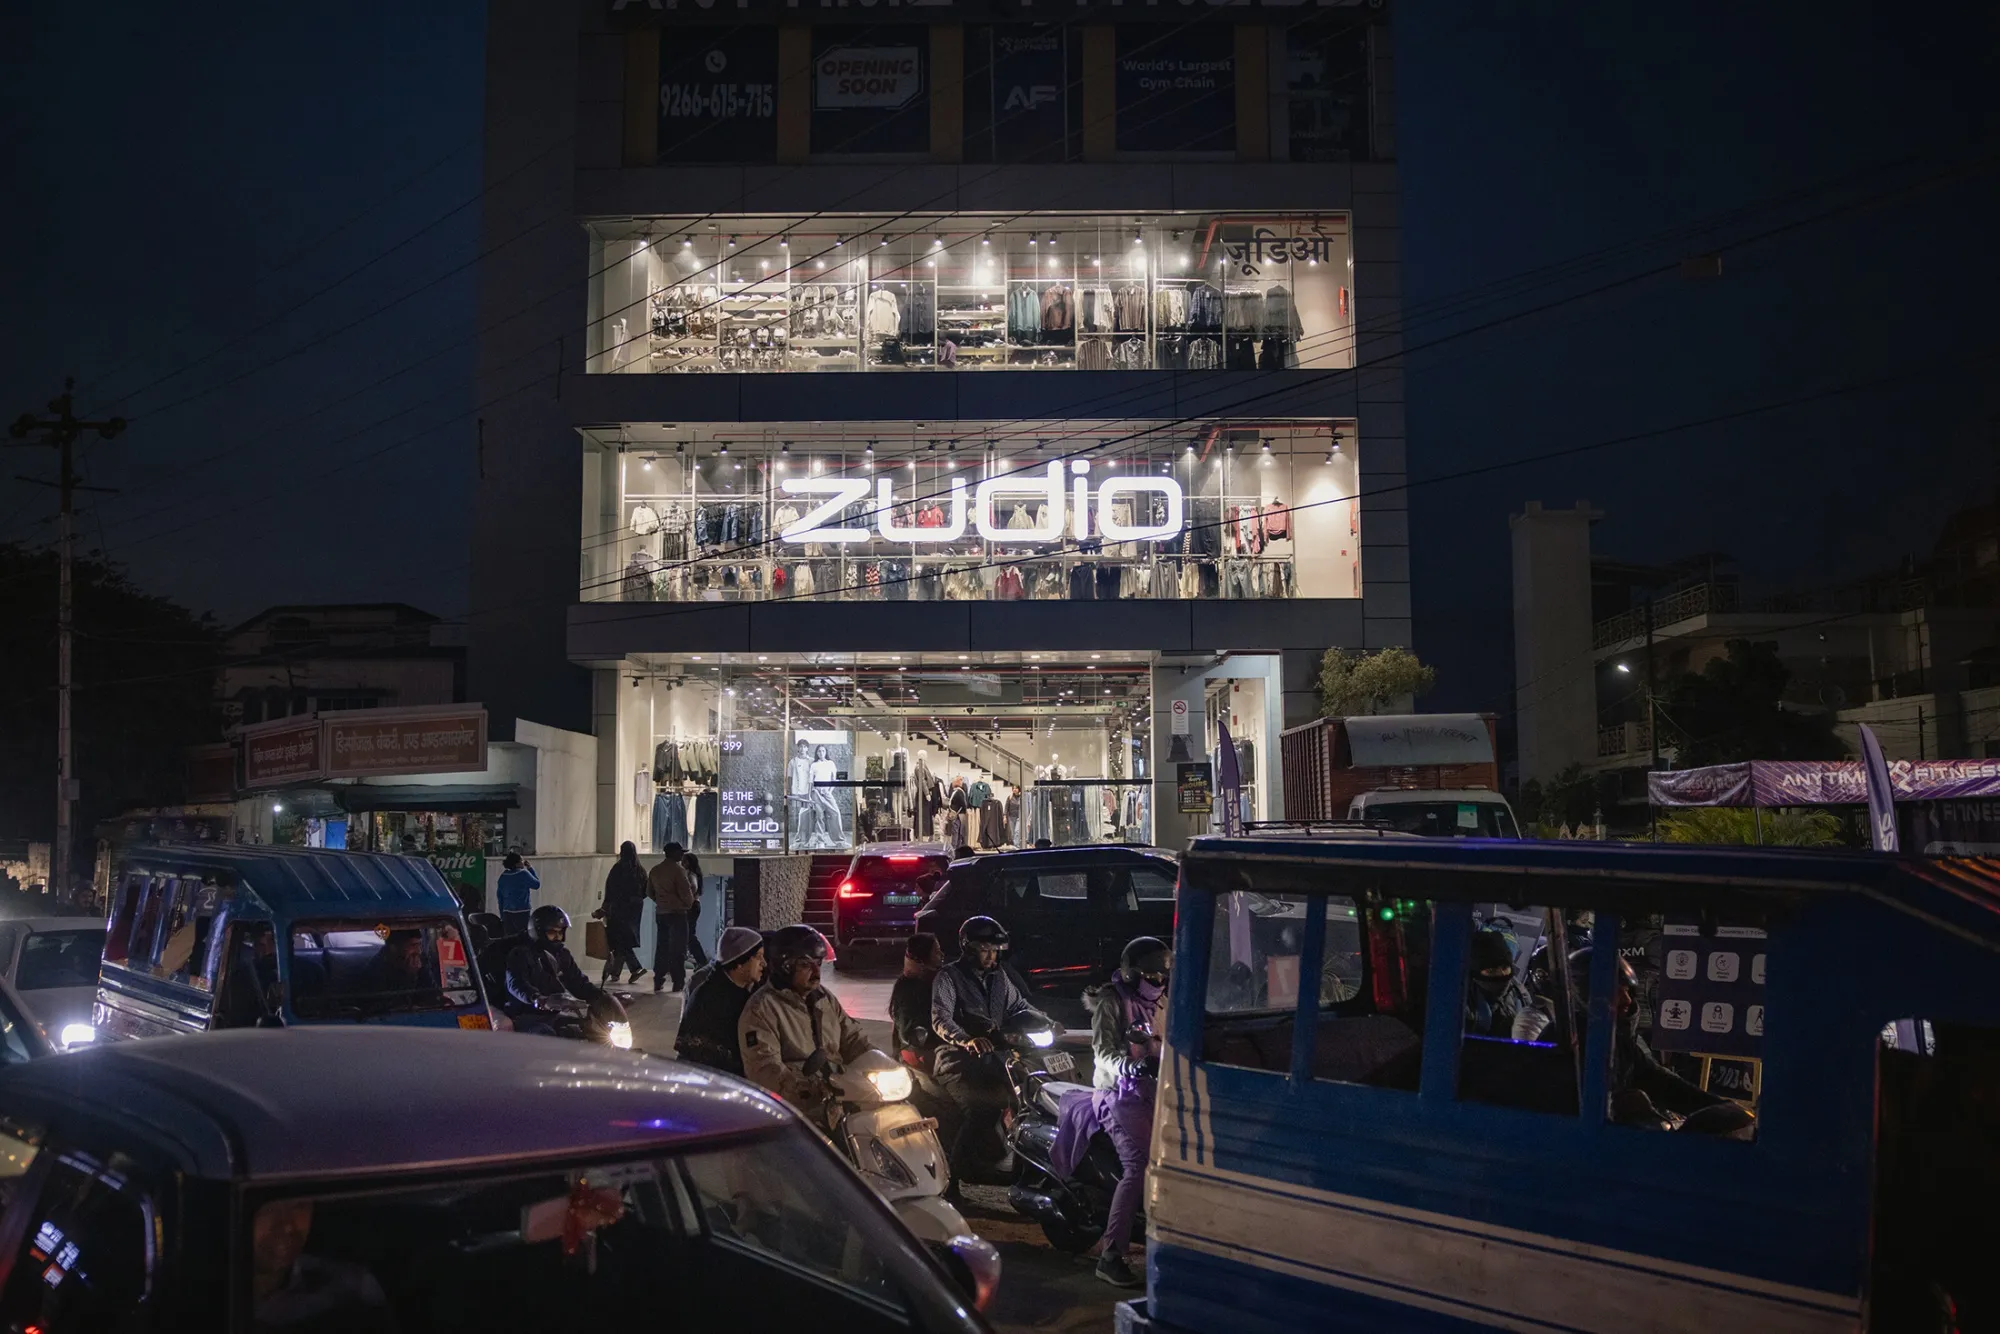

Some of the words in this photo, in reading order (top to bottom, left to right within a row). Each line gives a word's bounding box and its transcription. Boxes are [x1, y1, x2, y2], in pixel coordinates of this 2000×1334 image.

[821, 59, 913, 75] OPENING
[1122, 60, 1175, 71] World's
[1179, 60, 1231, 74] Largest
[838, 78, 897, 95] SOON
[1139, 77, 1171, 90] Gym
[1174, 76, 1215, 88] Chain
[660, 83, 772, 117] 9266-615-715
[1002, 84, 1056, 110] AF
[781, 459, 1183, 543] zudio
[1782, 770, 1866, 788] ANYTIM
[1914, 764, 2000, 781] FITNES
[722, 791, 734, 801] BE
[735, 791, 753, 801] THE
[722, 806, 746, 815] FACE
[748, 806, 762, 815] OF
[443, 941, 456, 959] 7
